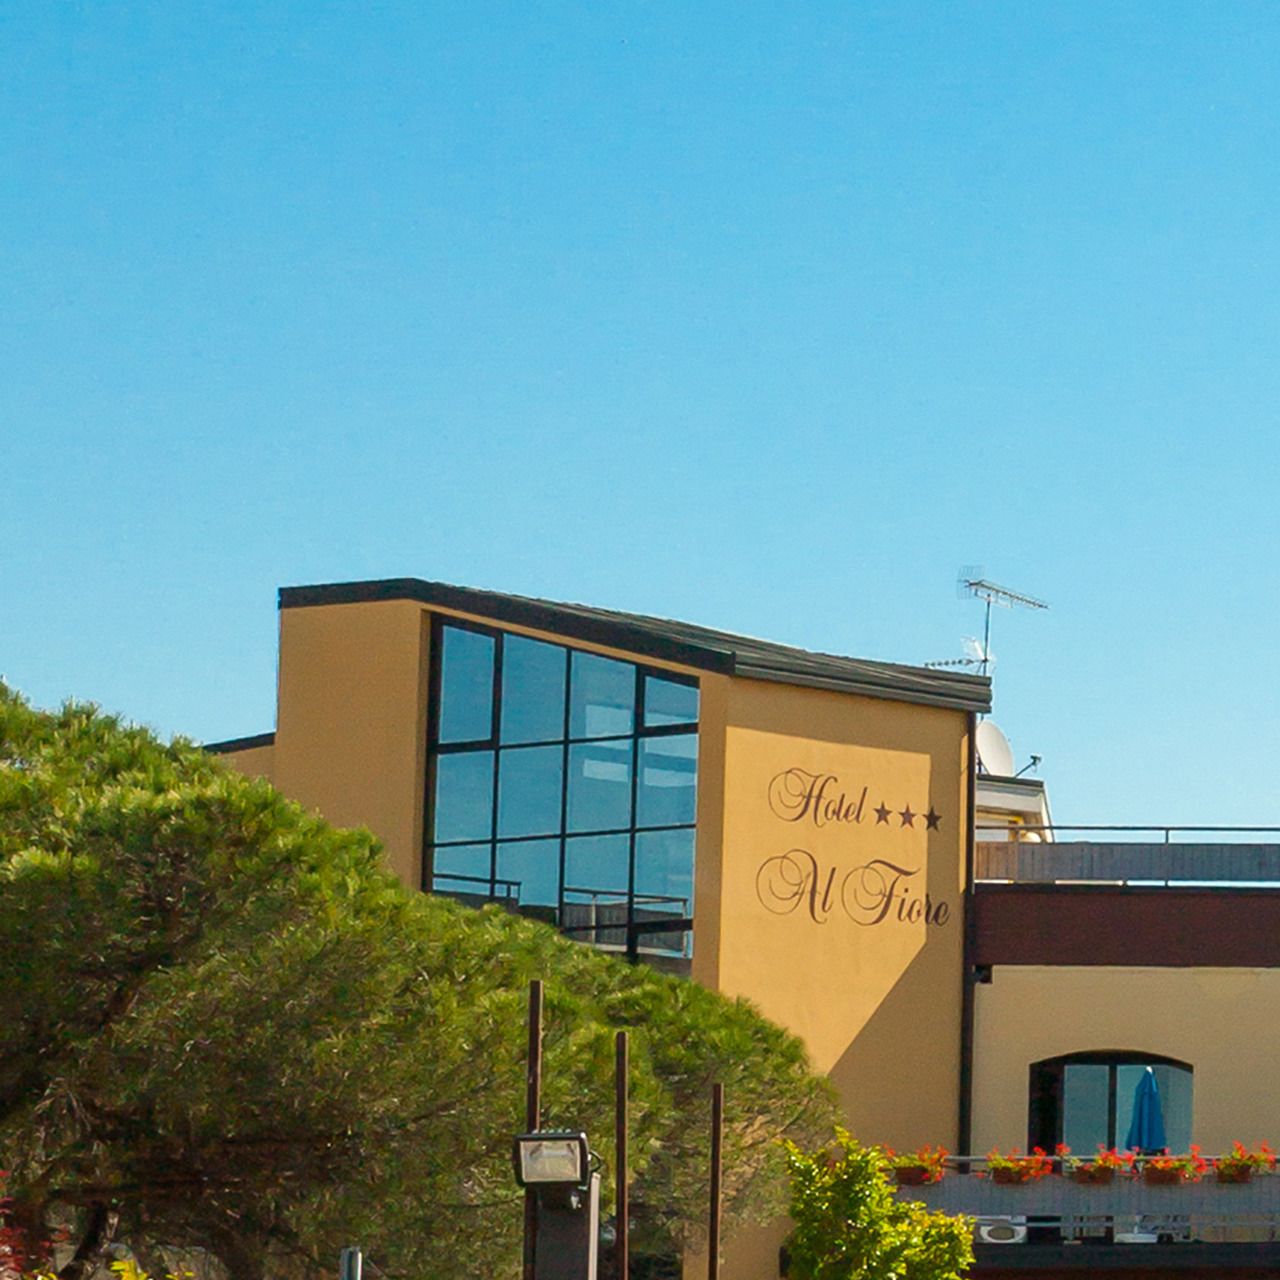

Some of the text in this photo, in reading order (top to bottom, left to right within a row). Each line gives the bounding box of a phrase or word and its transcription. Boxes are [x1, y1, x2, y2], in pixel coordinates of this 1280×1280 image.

[768, 767, 868, 828] Hotel
[755, 848, 950, 926] Al Fiore
